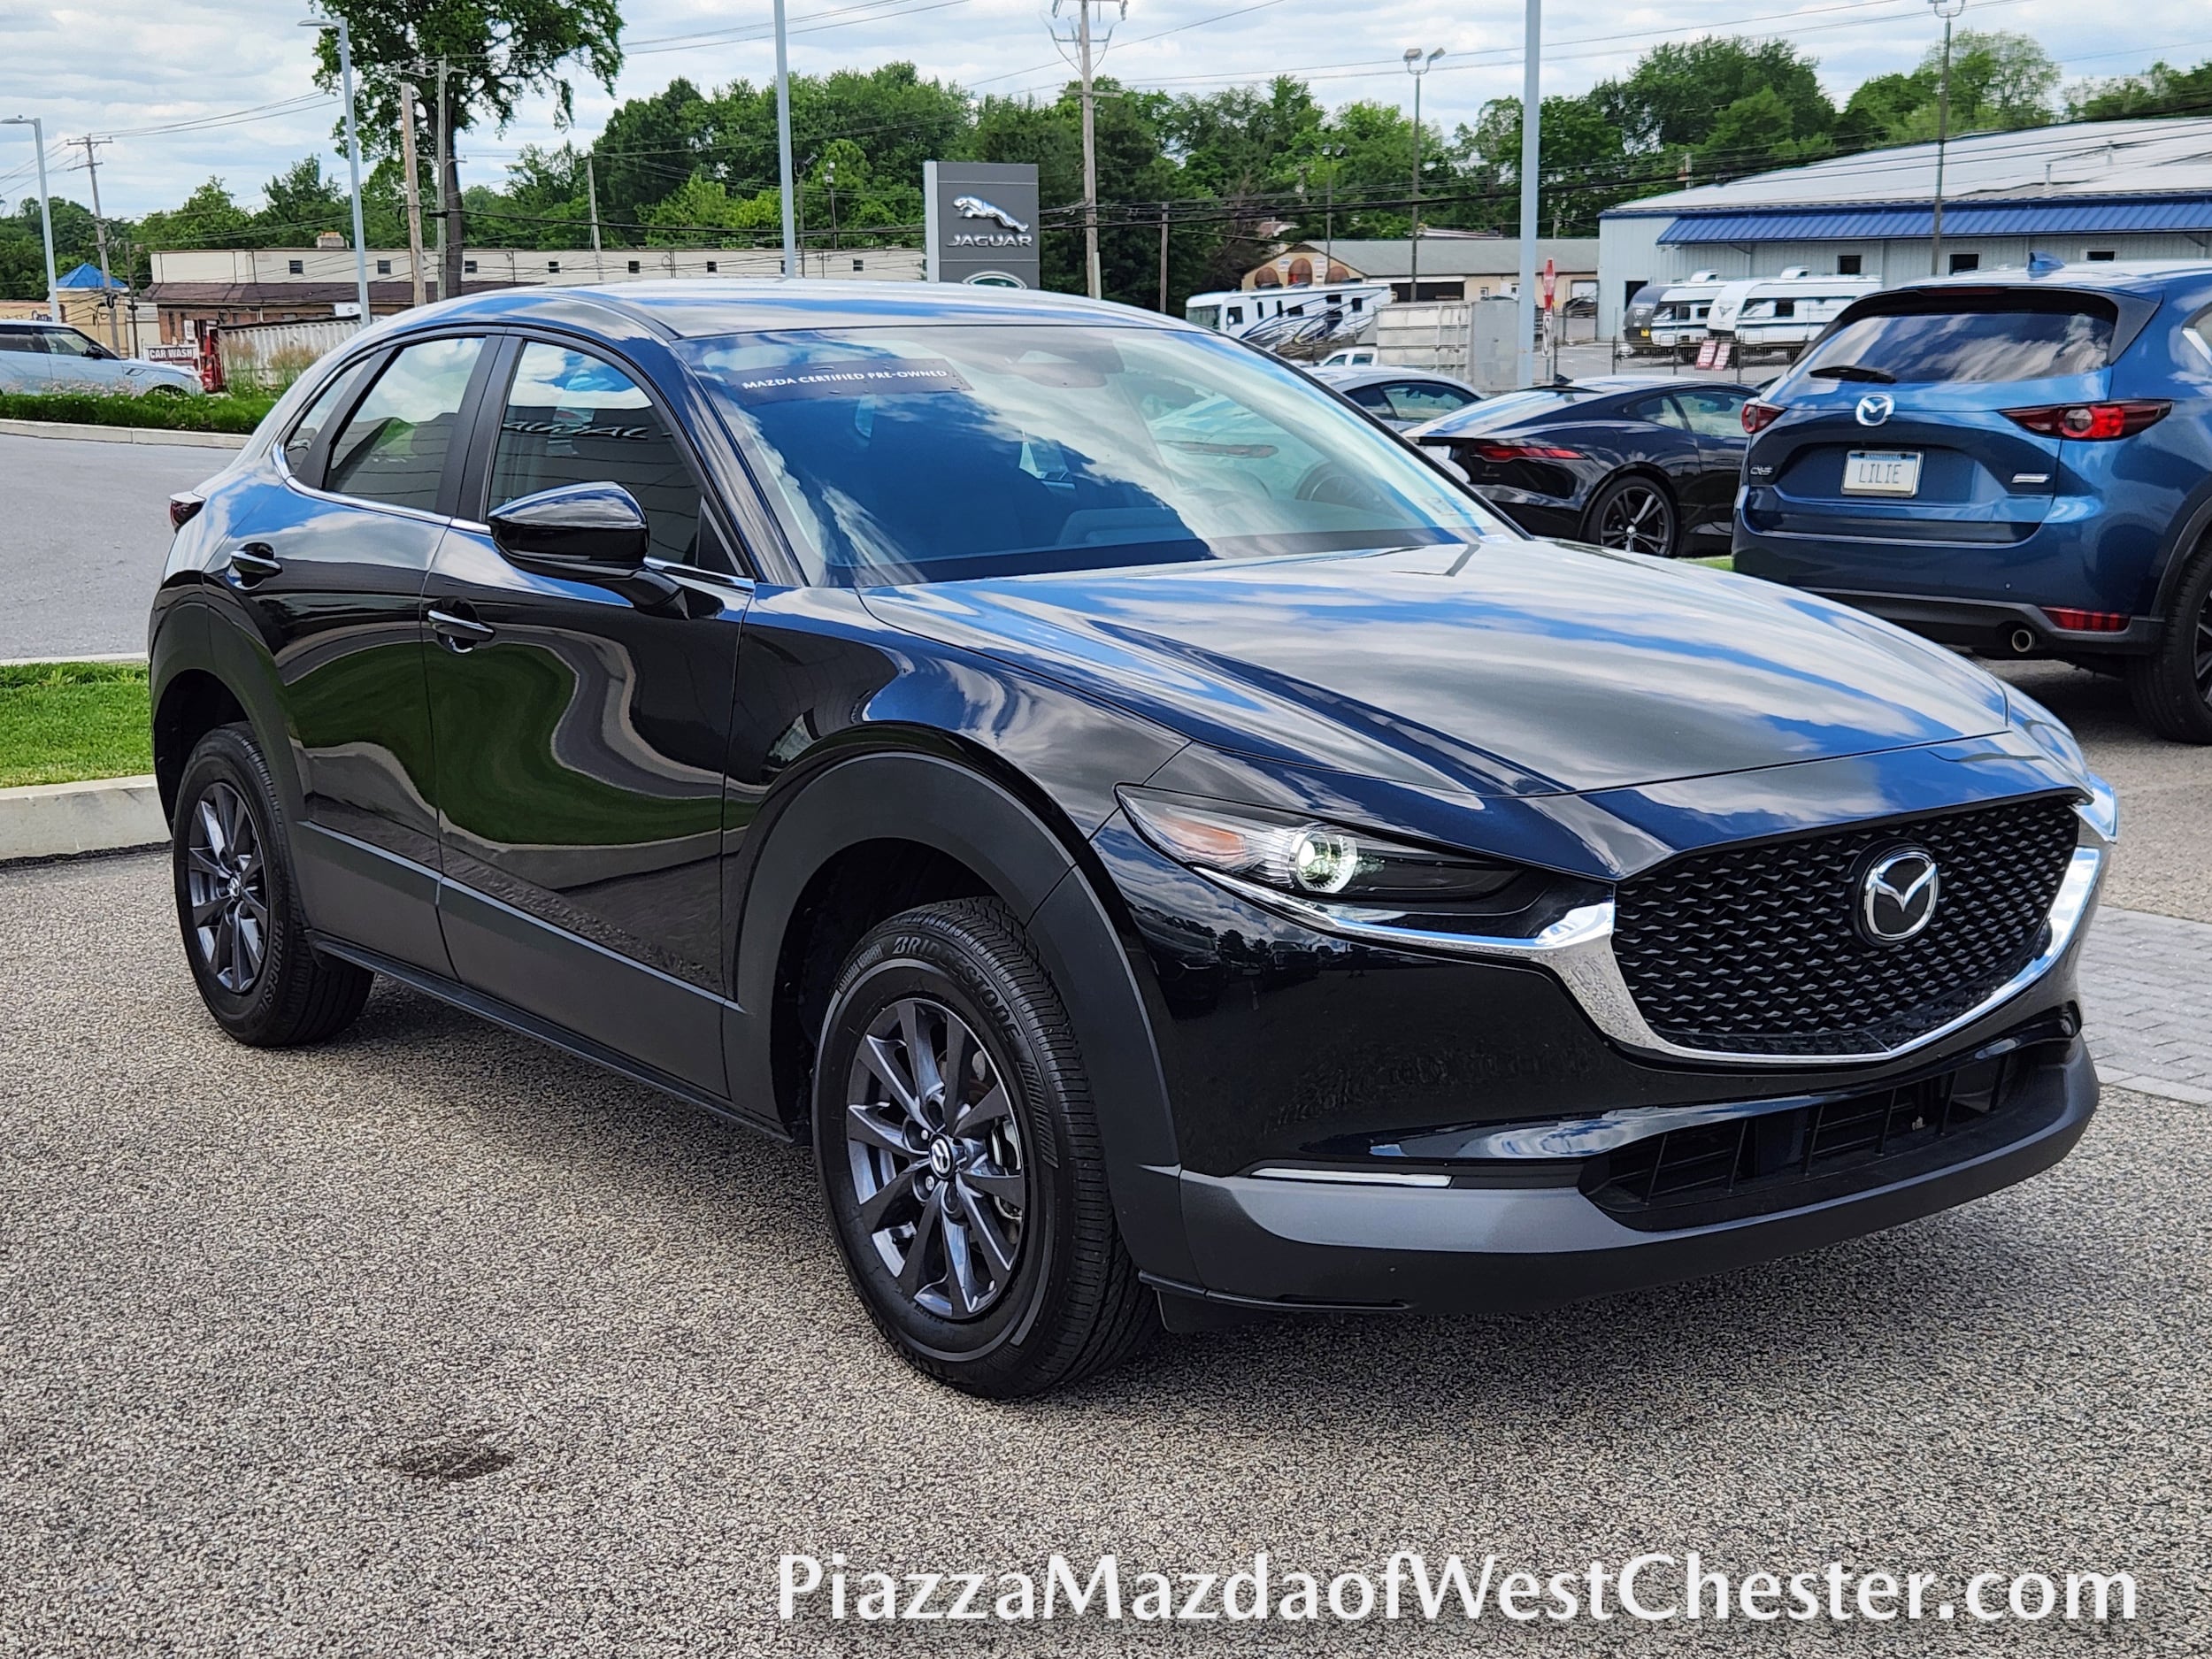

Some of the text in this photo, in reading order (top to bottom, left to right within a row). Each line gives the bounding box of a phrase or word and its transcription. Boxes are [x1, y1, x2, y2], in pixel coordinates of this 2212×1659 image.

[947, 234, 1033, 248] JAGUAR
[149, 348, 194, 359] CAR WASH
[741, 370, 948, 390] MAZDA CERTIFIED PRE-OWNED
[1859, 463, 1902, 484] LILIE
